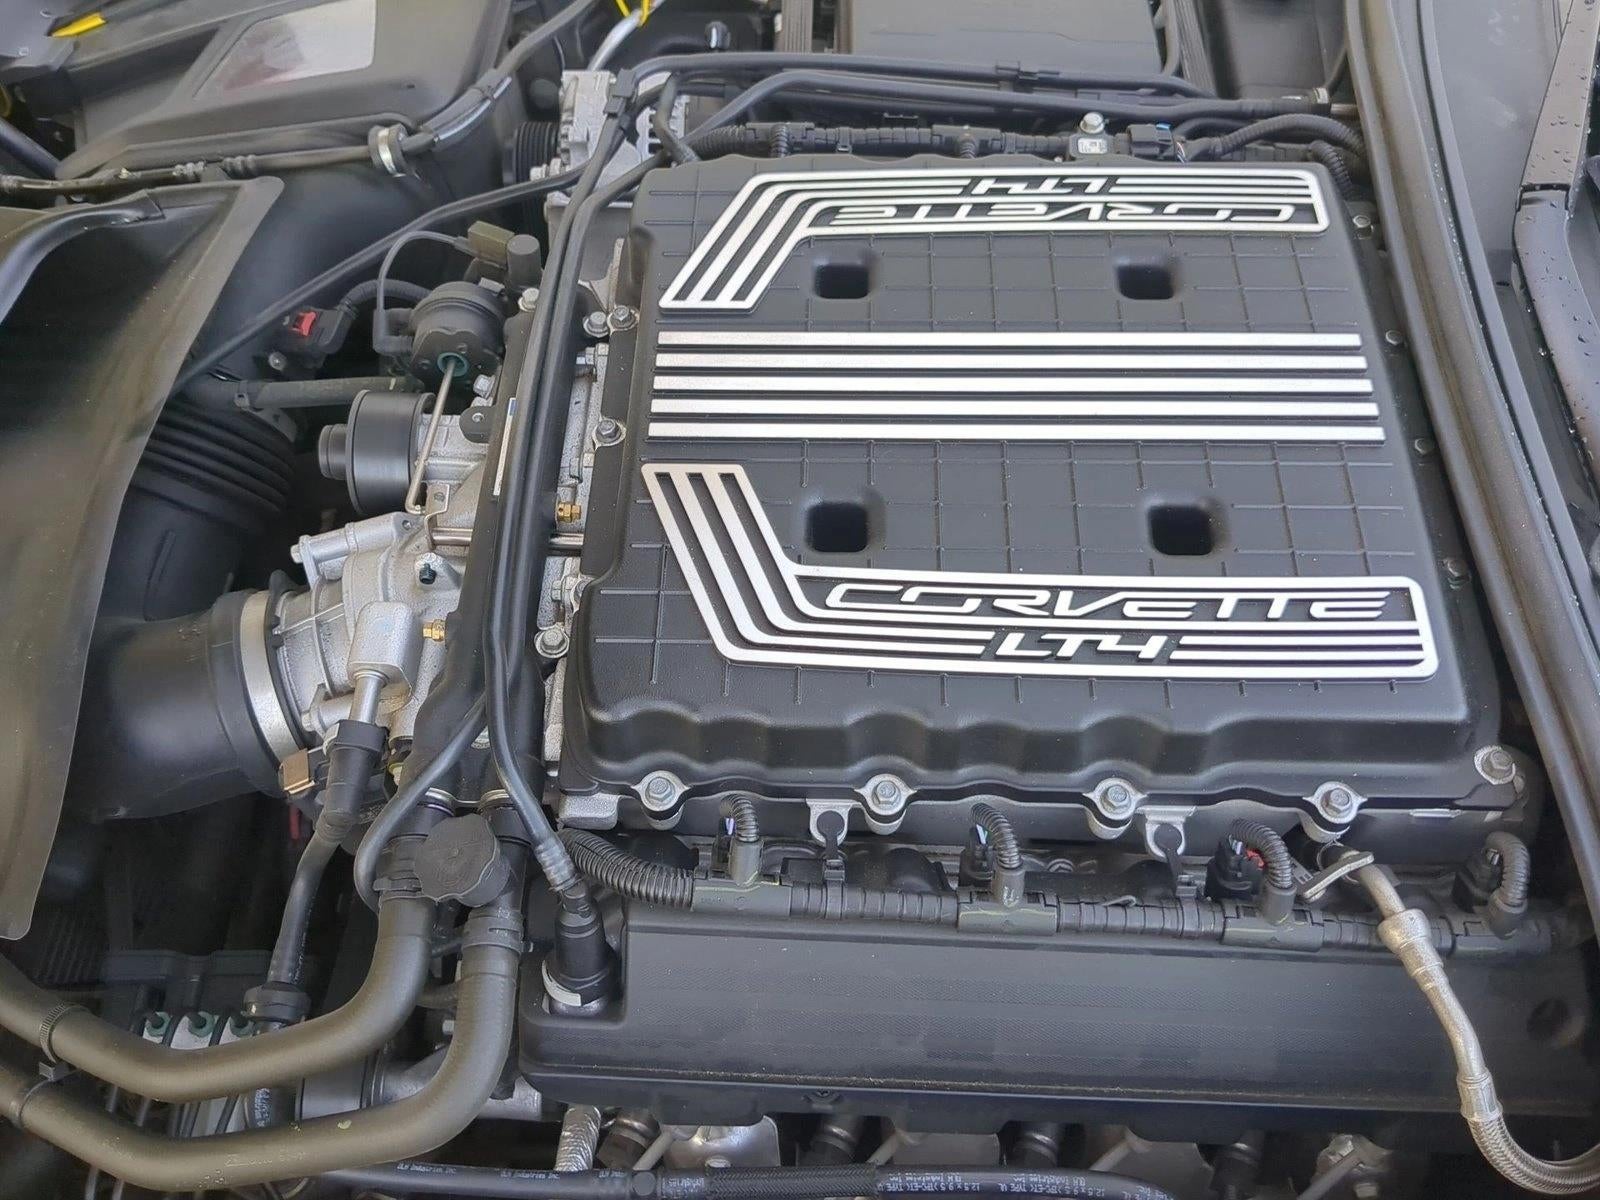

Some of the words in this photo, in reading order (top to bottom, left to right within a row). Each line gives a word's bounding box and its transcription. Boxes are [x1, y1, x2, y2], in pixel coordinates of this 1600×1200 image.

[970, 176, 1109, 195] LT4
[829, 200, 1296, 225] CORVETTE
[824, 582, 1389, 620] CORVETTE
[995, 630, 1170, 662] LT4
